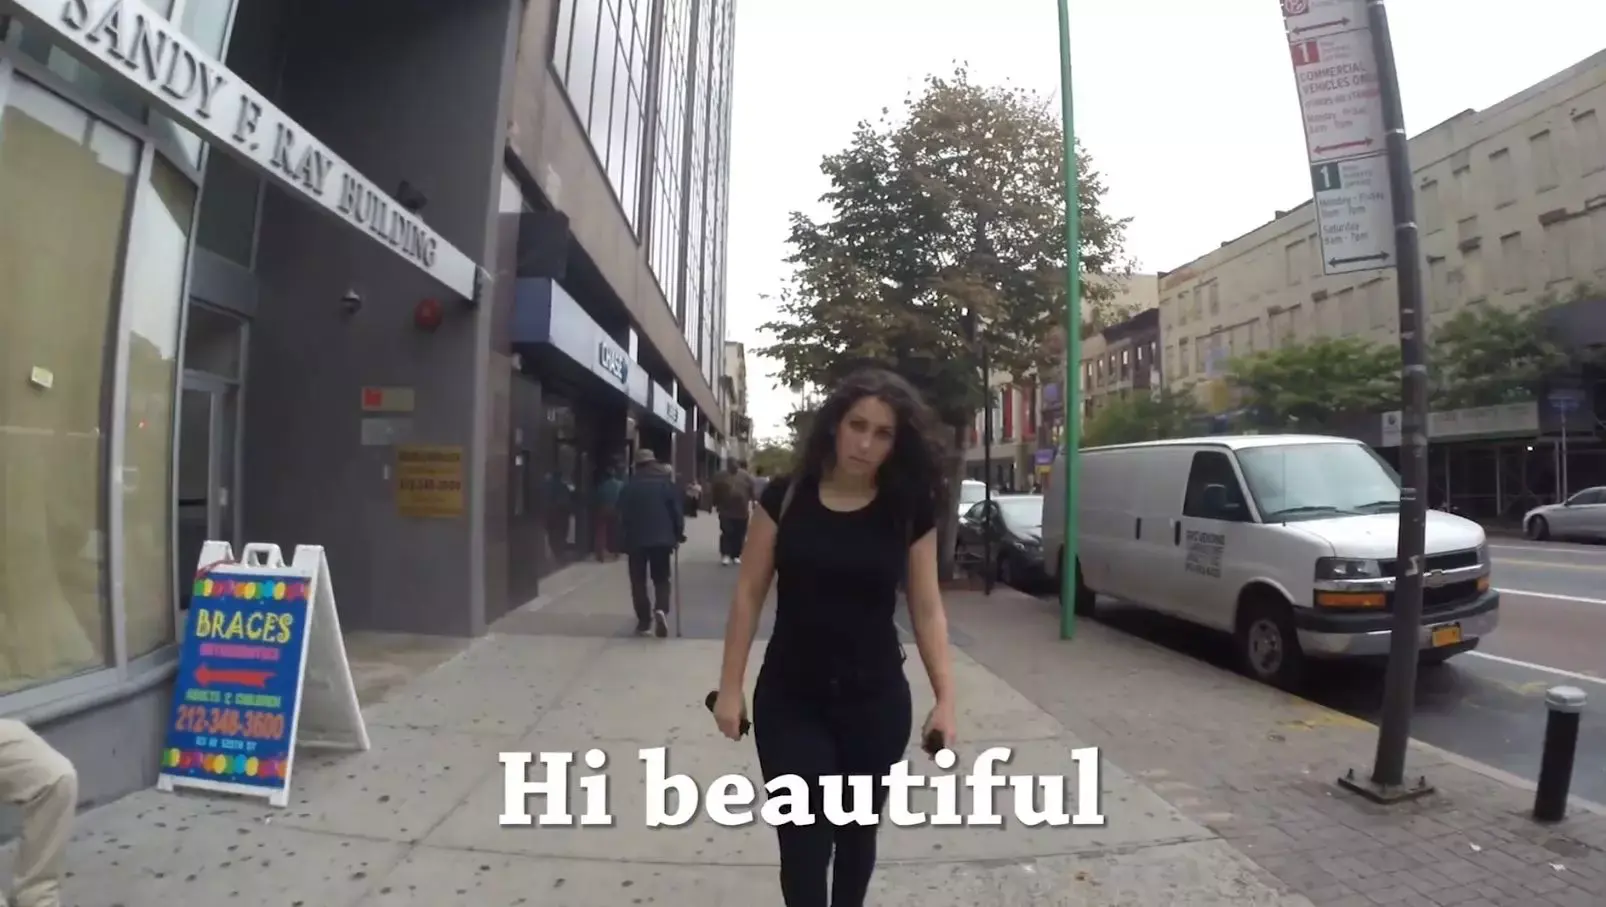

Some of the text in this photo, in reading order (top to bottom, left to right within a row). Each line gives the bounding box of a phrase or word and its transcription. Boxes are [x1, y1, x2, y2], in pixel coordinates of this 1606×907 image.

[1300, 61, 1367, 83] COMMERCIAL
[1302, 76, 1350, 95] VEHICLES
[61, 0, 227, 119] SANDY
[269, 121, 334, 196] RAY
[336, 171, 438, 268] BUILDING
[1320, 165, 1331, 188] 1
[1322, 221, 1360, 234] Saturday
[601, 342, 624, 380] CHASE
[196, 607, 294, 644] BRACES
